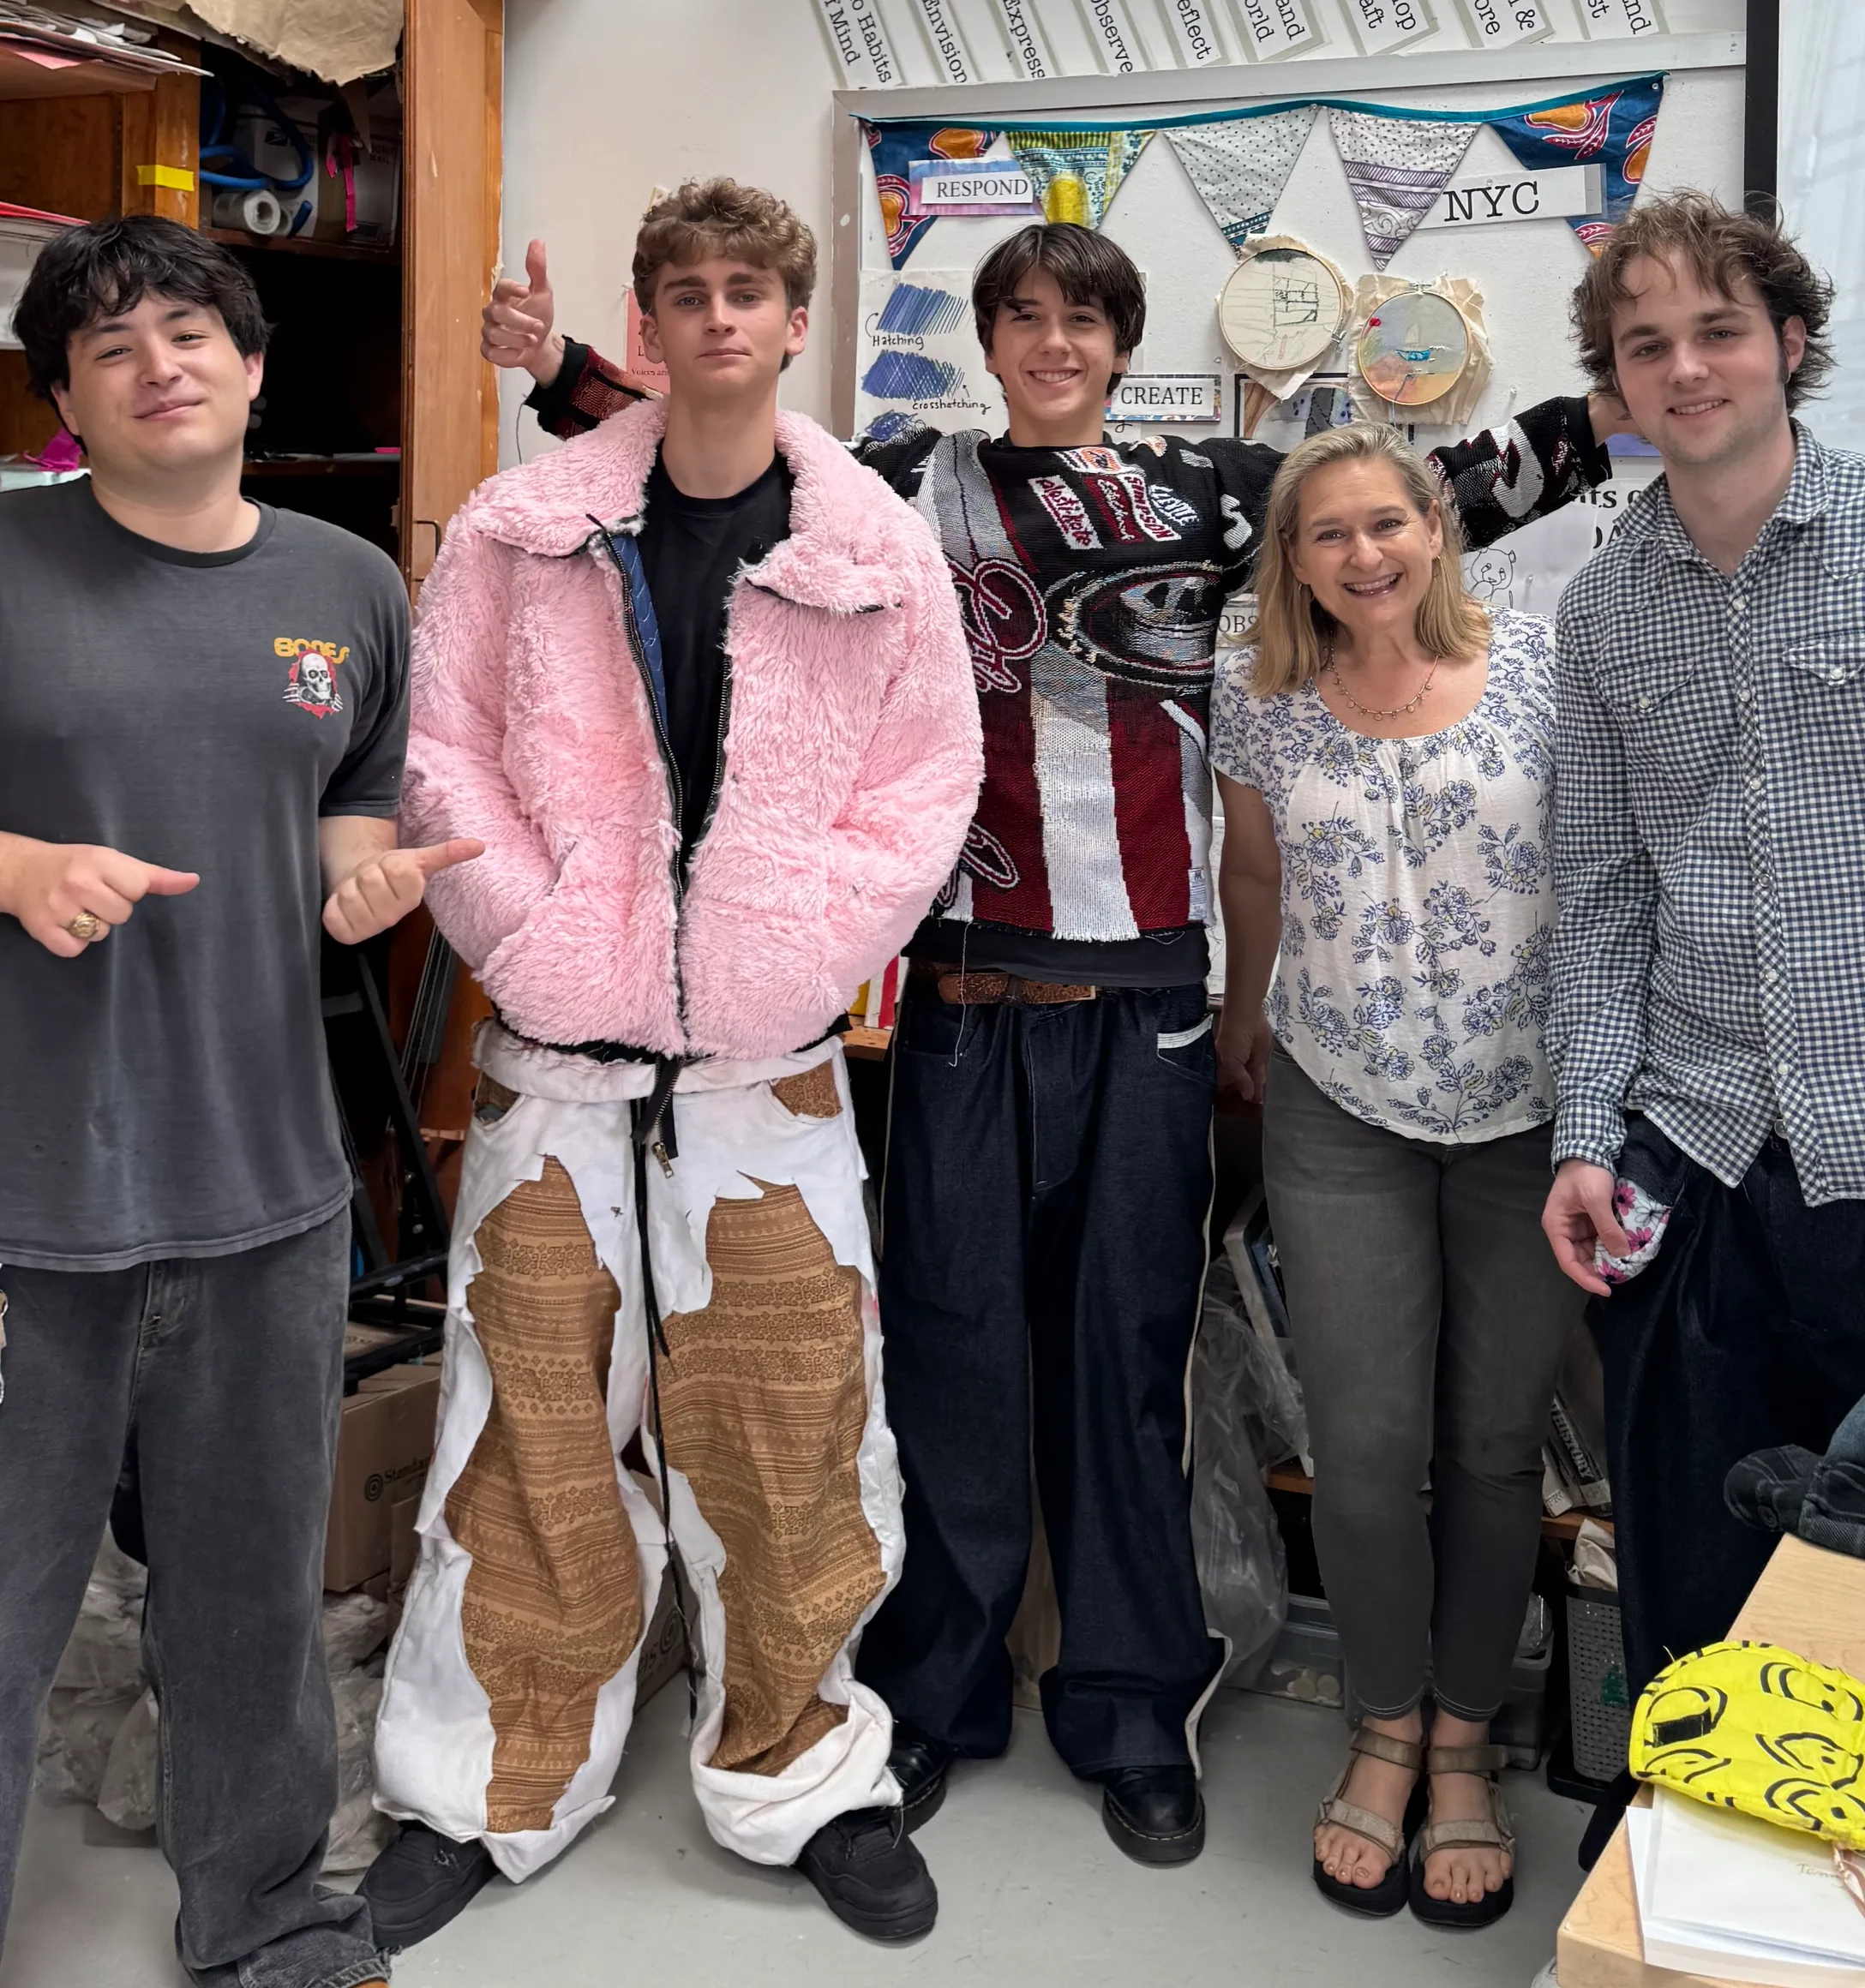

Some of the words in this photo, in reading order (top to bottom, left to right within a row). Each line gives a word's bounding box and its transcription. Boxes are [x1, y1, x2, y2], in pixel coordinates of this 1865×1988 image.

[1243, 0, 1274, 43] orld
[1275, 0, 1304, 40] and
[1358, 0, 1384, 29] aft
[1392, 0, 1416, 30] op
[1474, 0, 1500, 34] ore
[1515, 9, 1535, 30] &
[1587, 0, 1610, 18] st
[1622, 0, 1652, 34] nd
[830, 9, 861, 66] Mind
[922, 0, 968, 83] Envision
[1003, 0, 1045, 78] Express
[1178, 0, 1211, 60] eflect
[858, 12, 891, 83] Habits
[937, 179, 1028, 198] RESPOND
[1443, 181, 1539, 221] NYC
[873, 335, 925, 350] Hatching
[1121, 386, 1202, 405] CREATE
[273, 637, 351, 664] BONES
